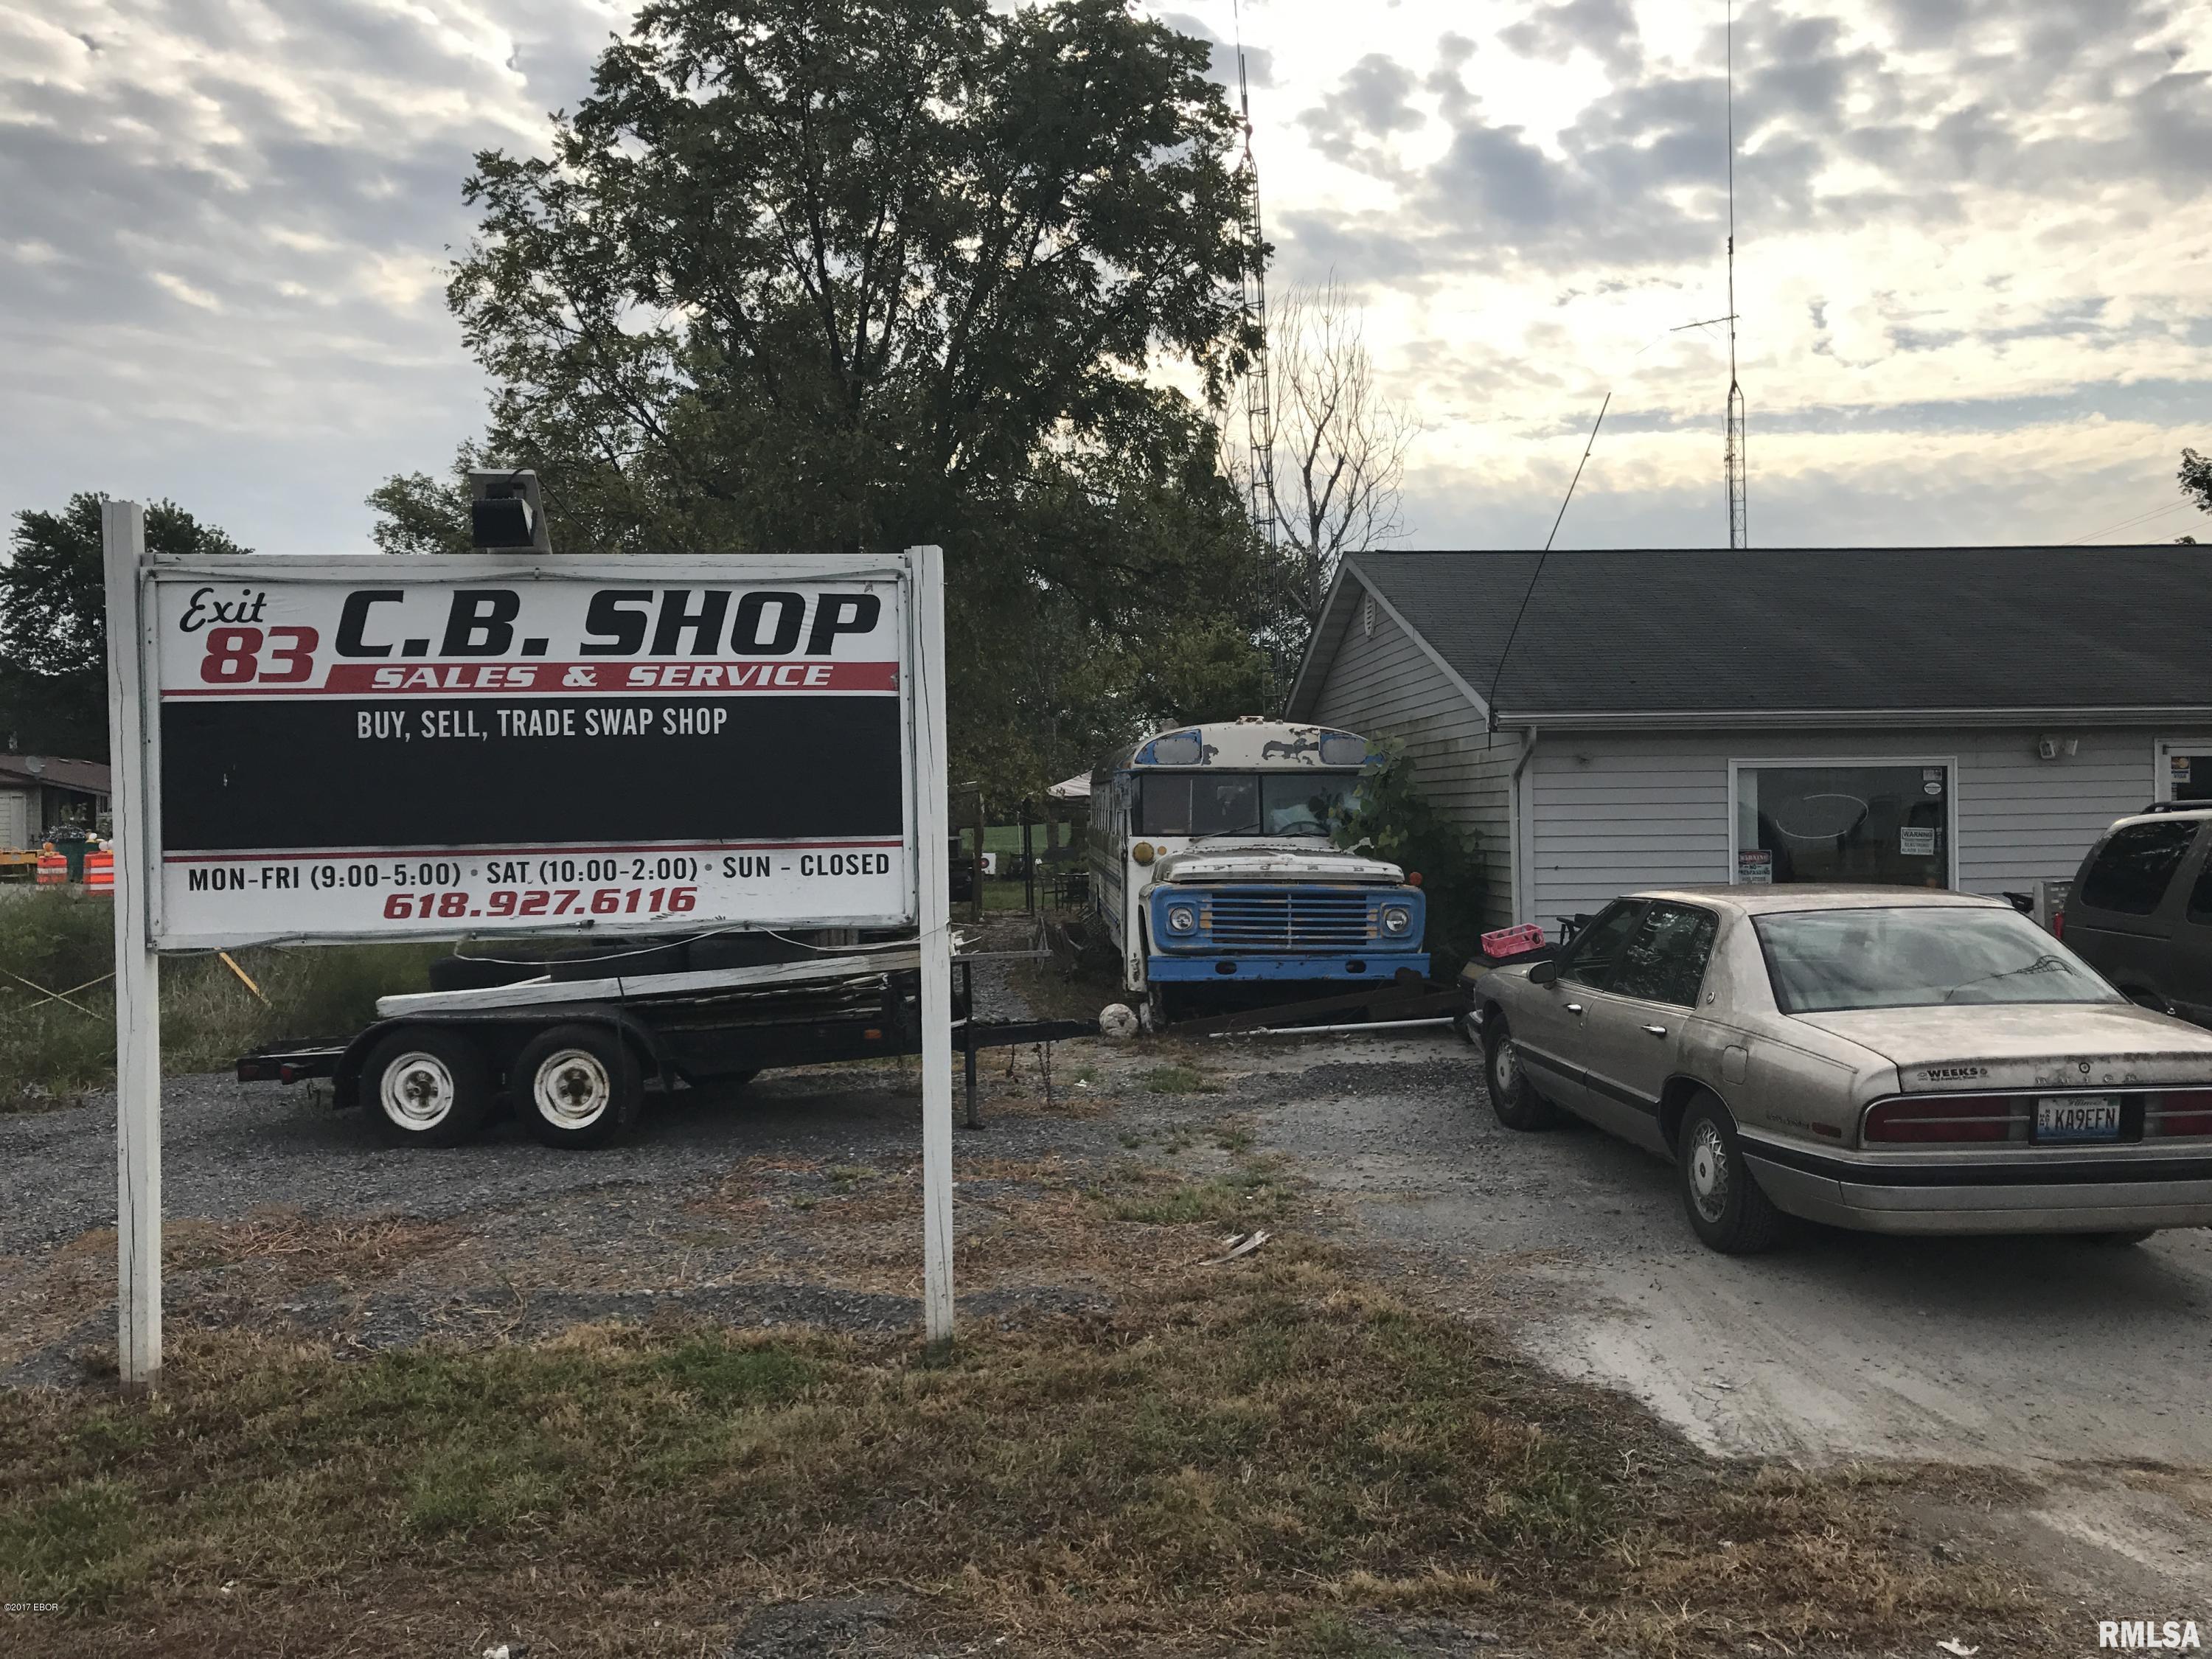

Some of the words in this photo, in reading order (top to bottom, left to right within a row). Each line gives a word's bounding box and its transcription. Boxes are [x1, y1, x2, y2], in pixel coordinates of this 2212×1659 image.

[180, 588, 267, 632] Exit
[335, 589, 549, 657] C.B.
[579, 590, 881, 655] SHOP
[201, 626, 319, 683] 83
[372, 667, 538, 689] SALES
[562, 666, 598, 686] &
[626, 665, 833, 686] SERVICE
[358, 710, 411, 741] BUY,
[421, 710, 488, 741] SELL,
[497, 709, 575, 737] TRADE
[585, 708, 653, 736] SWAP
[663, 708, 727, 734] SHOP
[189, 866, 299, 891] MON-FRI
[310, 863, 461, 889] (9:00-5:00)
[487, 861, 530, 883] SAT
[539, 858, 698, 884] (10:00-2:00)
[723, 856, 771, 878] SUN
[800, 854, 889, 876] CLOSED
[383, 887, 697, 919] 618.927.6116
[1927, 1067, 1978, 1077] WEEKS
[2055, 1108, 2115, 1130] KA9EFN
